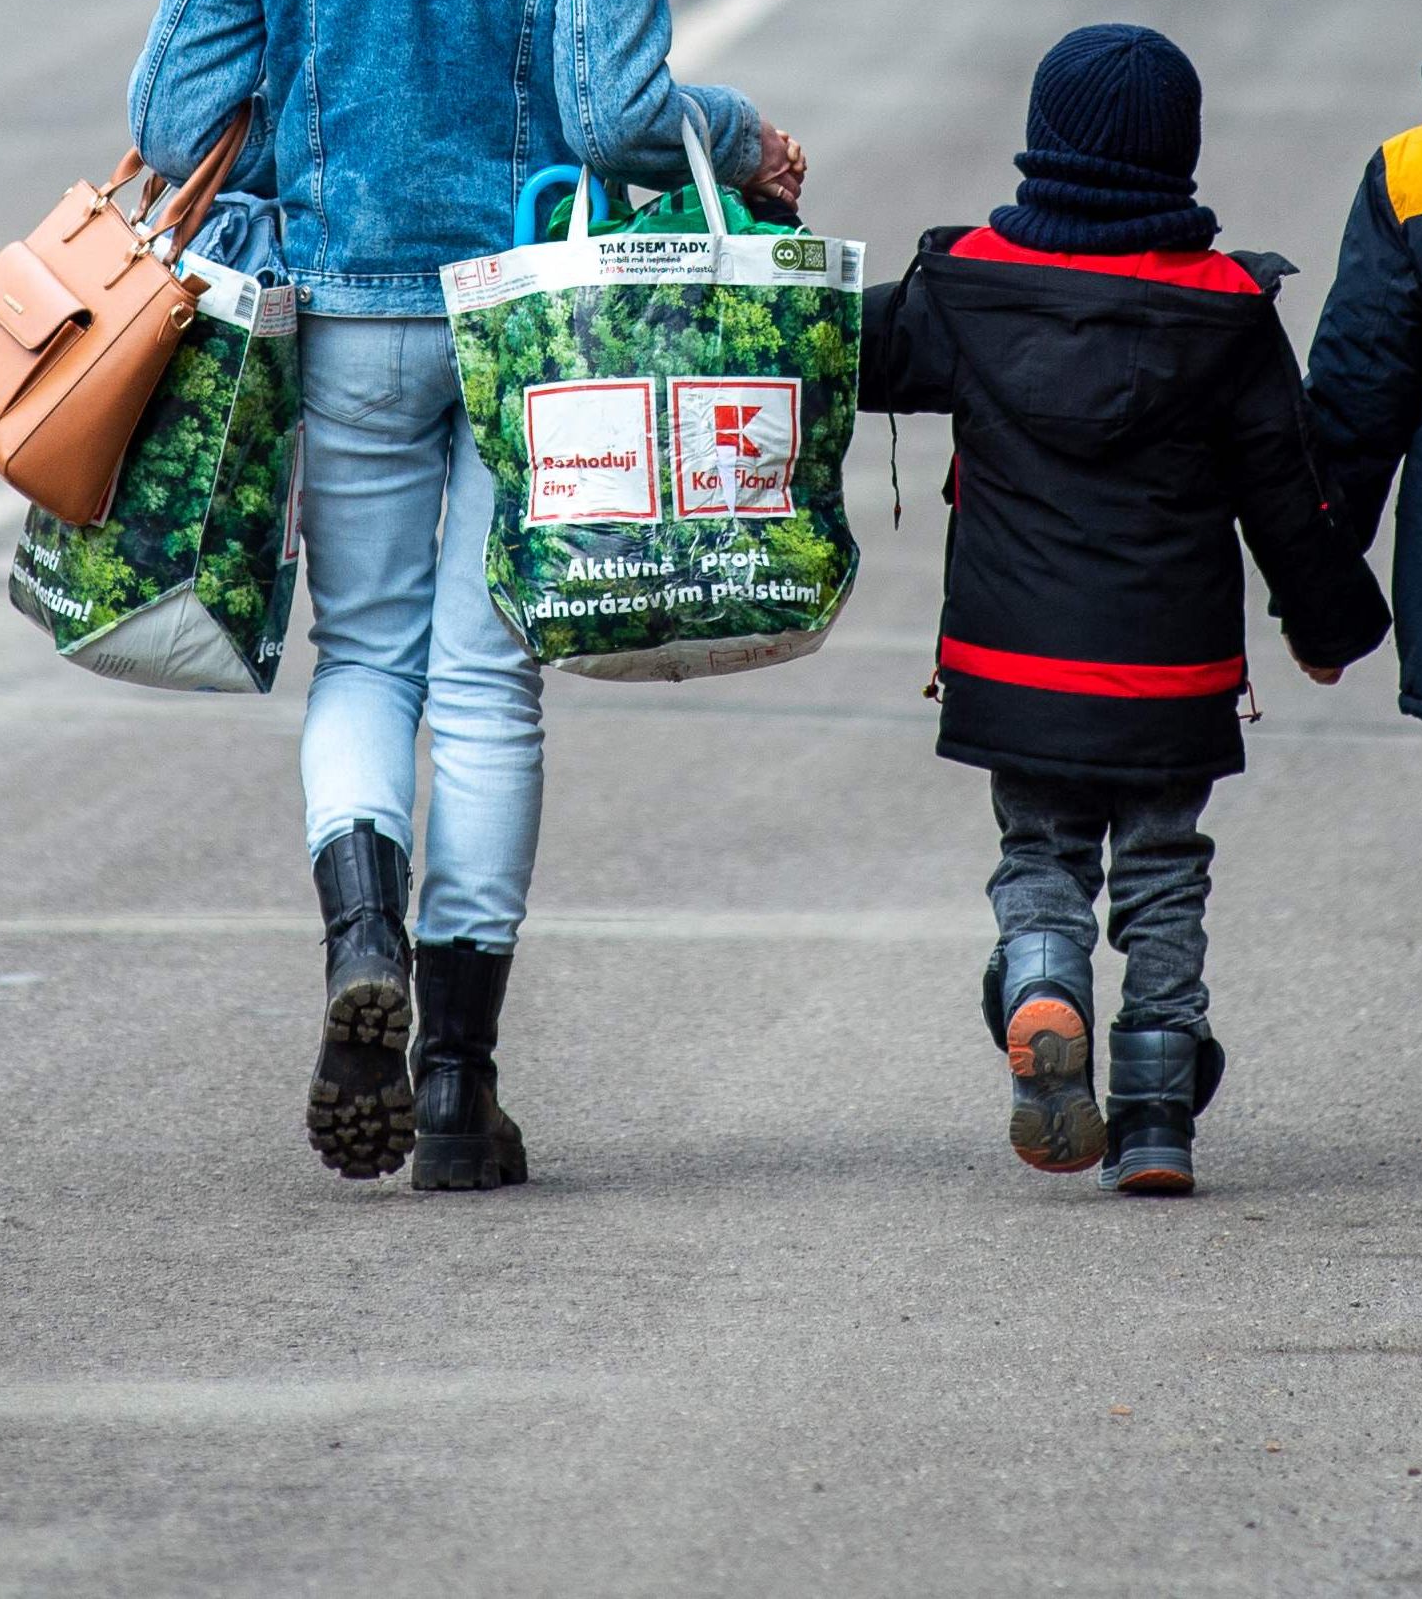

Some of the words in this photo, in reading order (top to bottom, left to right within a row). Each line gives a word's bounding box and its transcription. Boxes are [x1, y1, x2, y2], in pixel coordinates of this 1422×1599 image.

[599, 242, 625, 254] TAK
[630, 242, 666, 253] JSEM
[670, 242, 710, 253] TADY.
[542, 451, 637, 472] Rozhodují
[542, 480, 577, 498] činy
[34, 544, 61, 572] proti
[566, 555, 675, 581] Aktivně
[701, 547, 770, 573] proti
